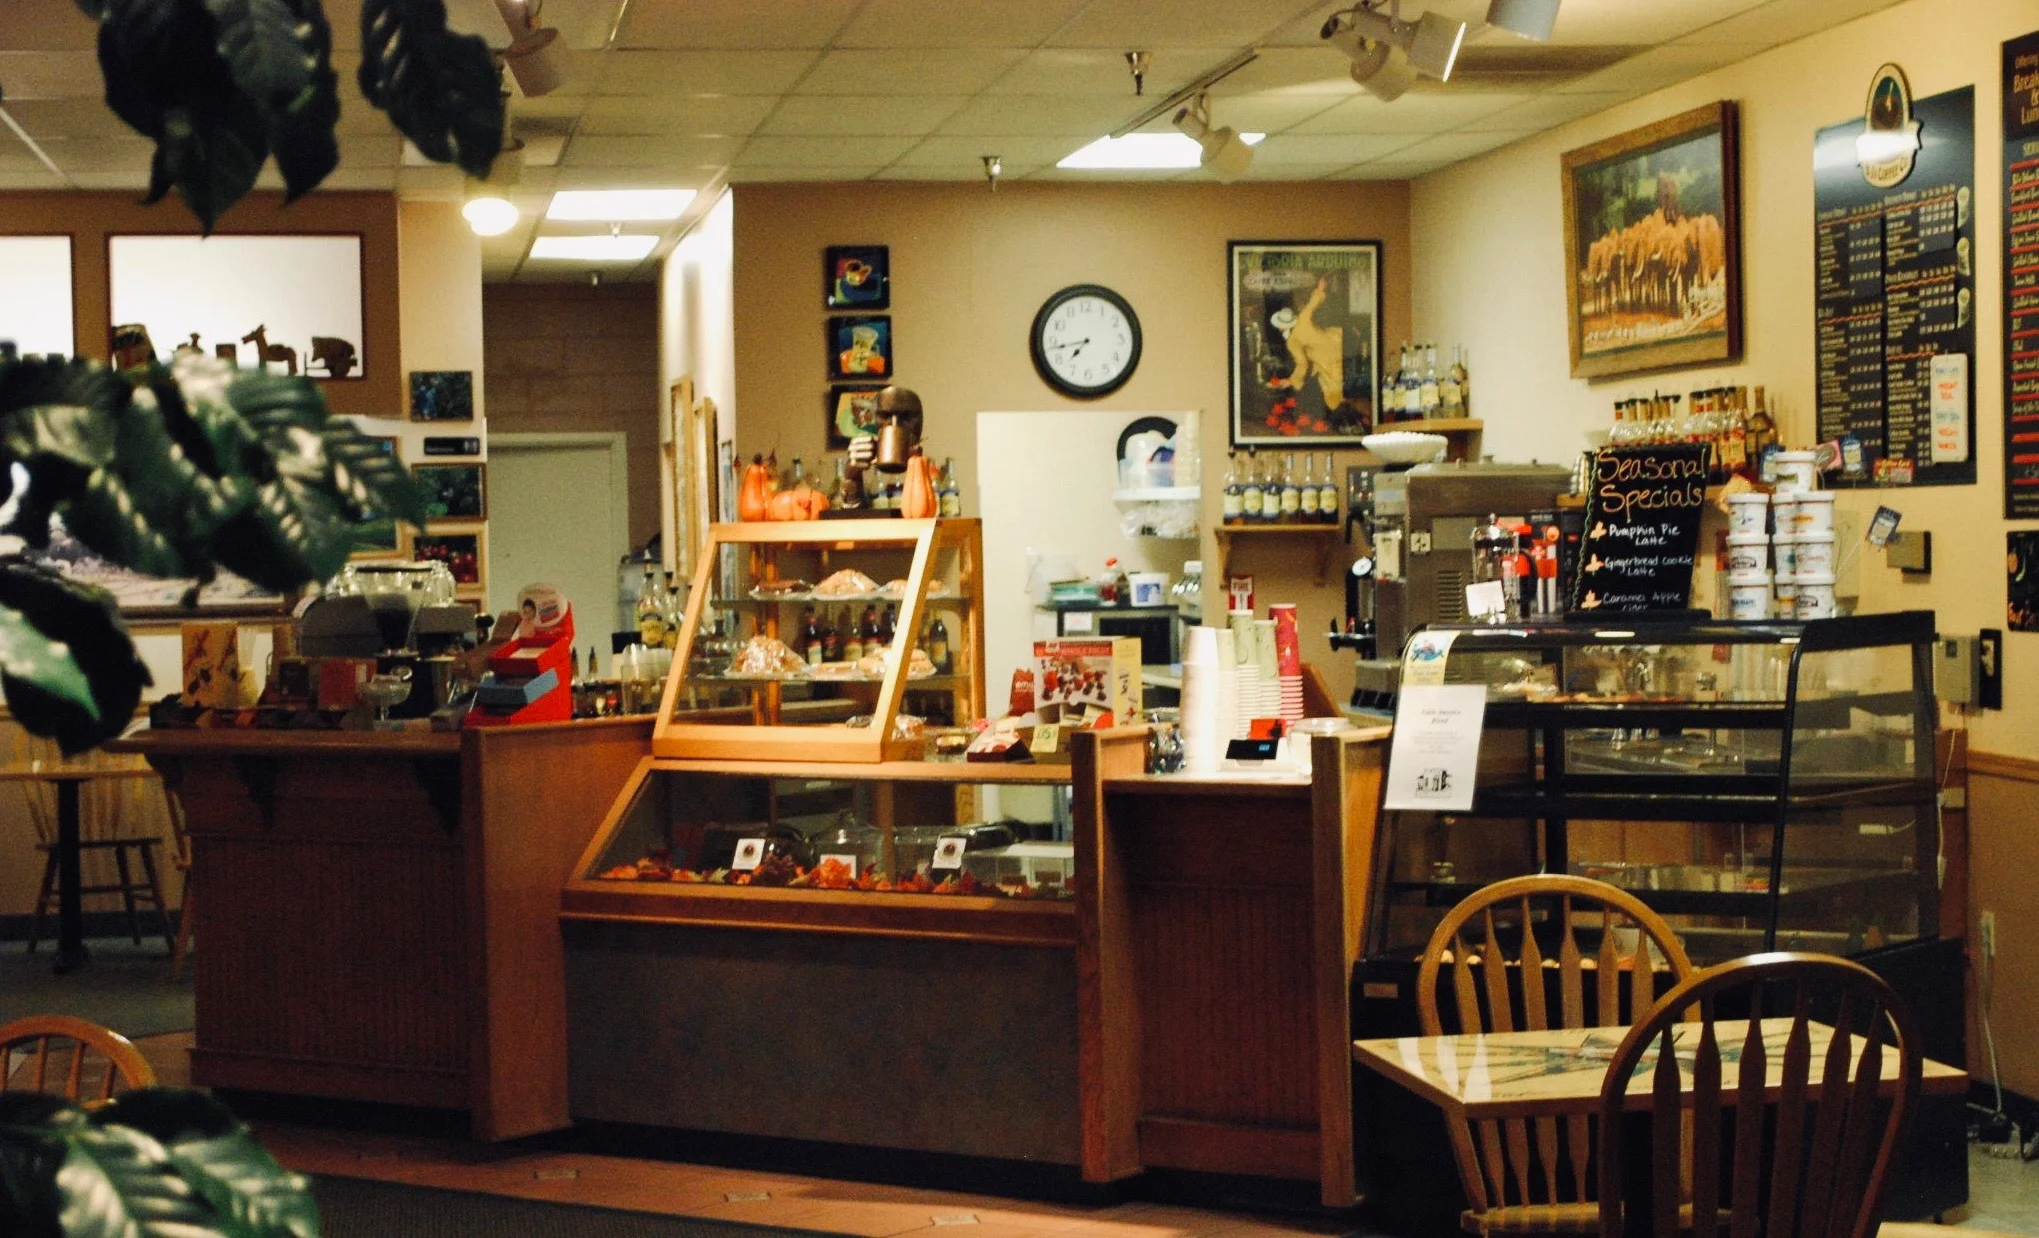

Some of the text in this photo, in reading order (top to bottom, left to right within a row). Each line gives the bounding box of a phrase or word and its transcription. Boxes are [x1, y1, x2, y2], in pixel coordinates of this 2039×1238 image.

[1066, 305, 1075, 318] 11
[1081, 300, 1092, 313] 12
[1112, 315, 1119, 328] 2
[1118, 333, 1125, 346] 3
[1112, 351, 1119, 363] 4
[1070, 364, 1077, 377] 7
[1084, 368, 1093, 381] 6
[1102, 363, 1110, 376] 5
[1597, 448, 1707, 482] Seasonal
[1600, 483, 1703, 523] Specials
[1609, 522, 1682, 540] Pumpkin Pie
[1635, 535, 1668, 546] Latte
[1604, 554, 1659, 574] Gingerbread
[1627, 566, 1656, 578] Latte
[1233, 582, 1250, 591] FIRE
